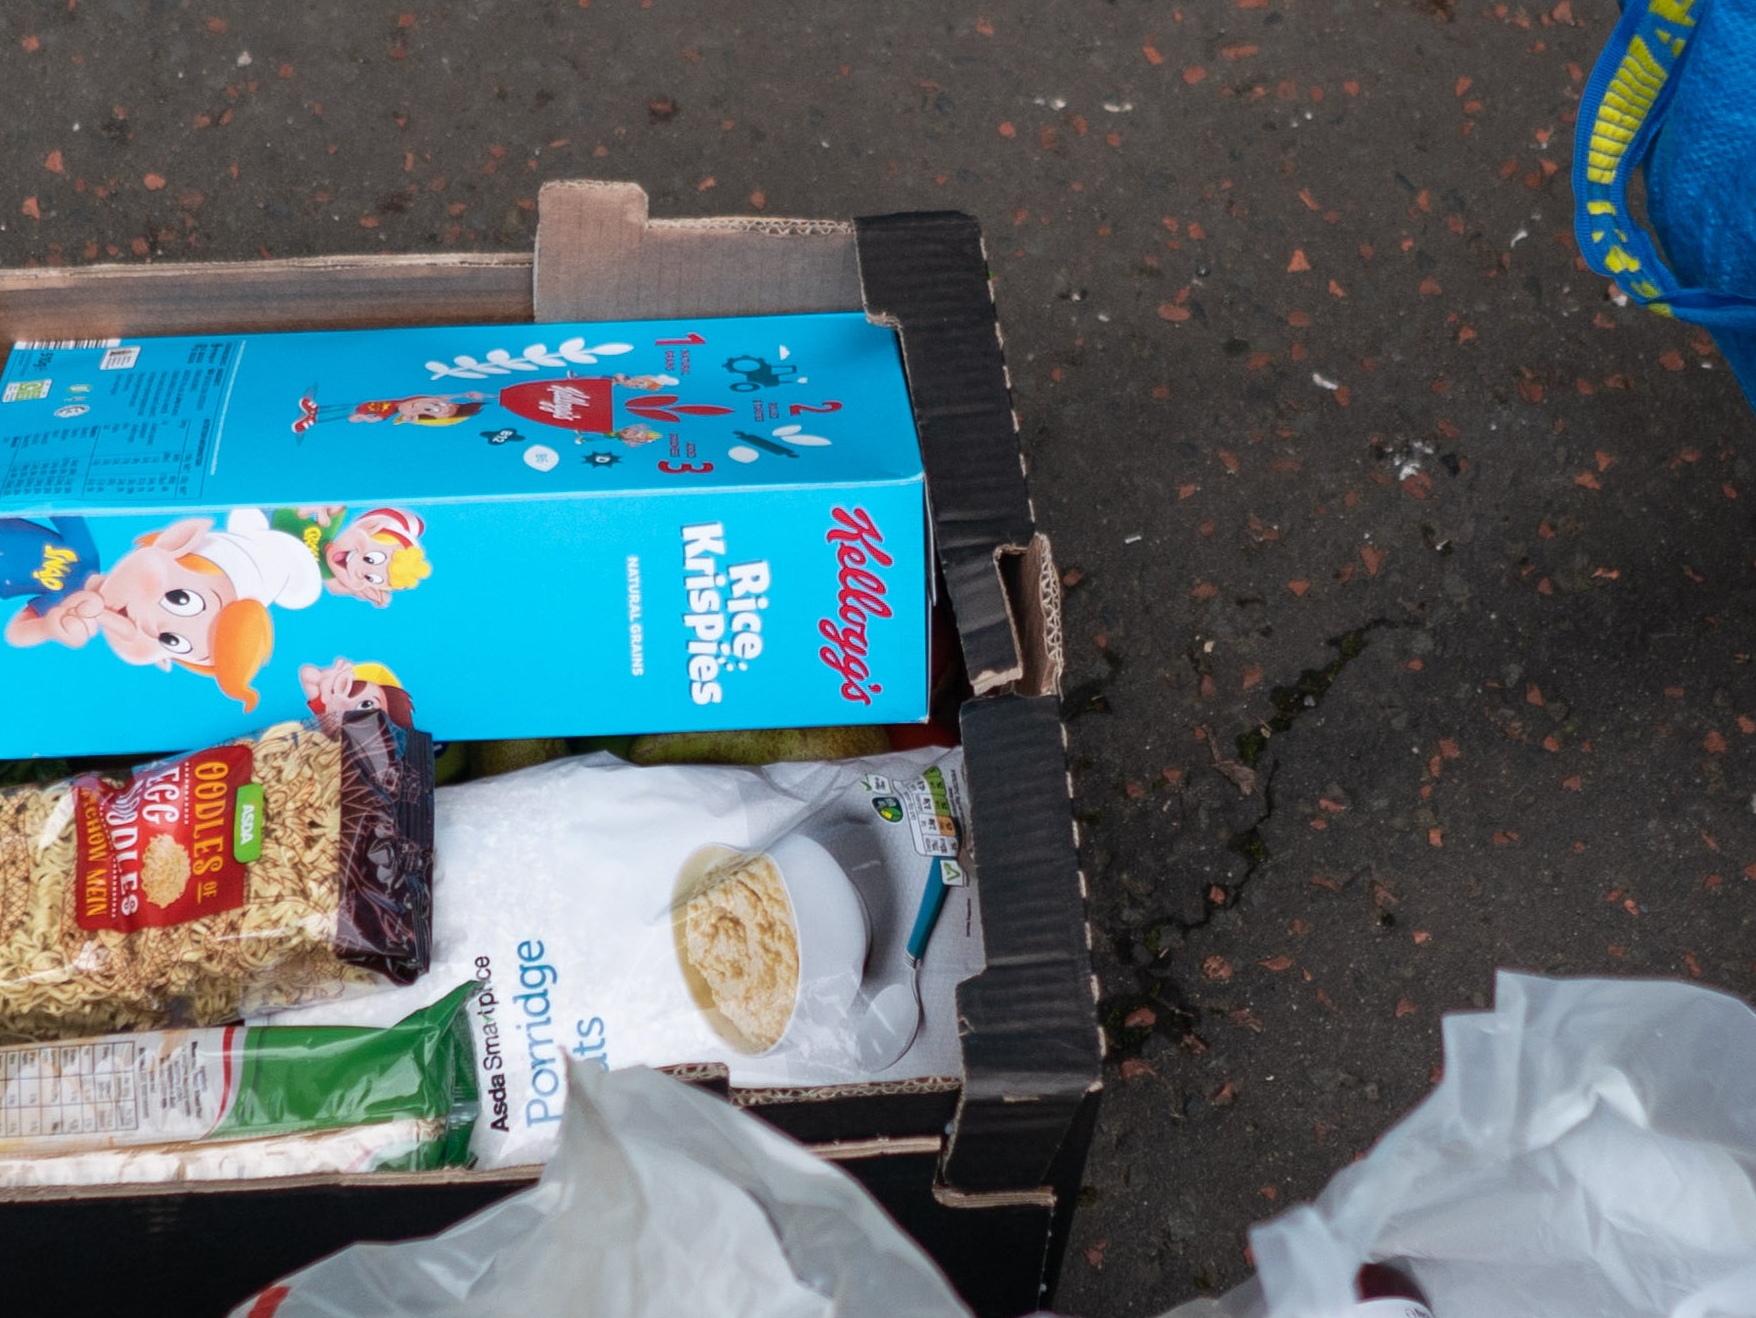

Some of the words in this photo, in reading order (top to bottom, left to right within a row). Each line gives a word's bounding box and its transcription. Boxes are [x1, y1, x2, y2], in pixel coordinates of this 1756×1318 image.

[788, 400, 844, 417] 2
[657, 459, 715, 475] 3
[626, 555, 643, 621] NATURAL
[681, 521, 728, 706] Krispies
[726, 559, 772, 661] Rice
[818, 506, 894, 707] Kellogg's
[629, 623, 644, 677] GRAINS
[142, 766, 181, 825] EGG
[192, 760, 229, 877] OODLES
[239, 803, 256, 847] ASDA
[85, 868, 108, 917] MEIN
[202, 880, 218, 899] OF
[511, 939, 563, 1129] Porridge
[488, 1072, 510, 1133] Asda
